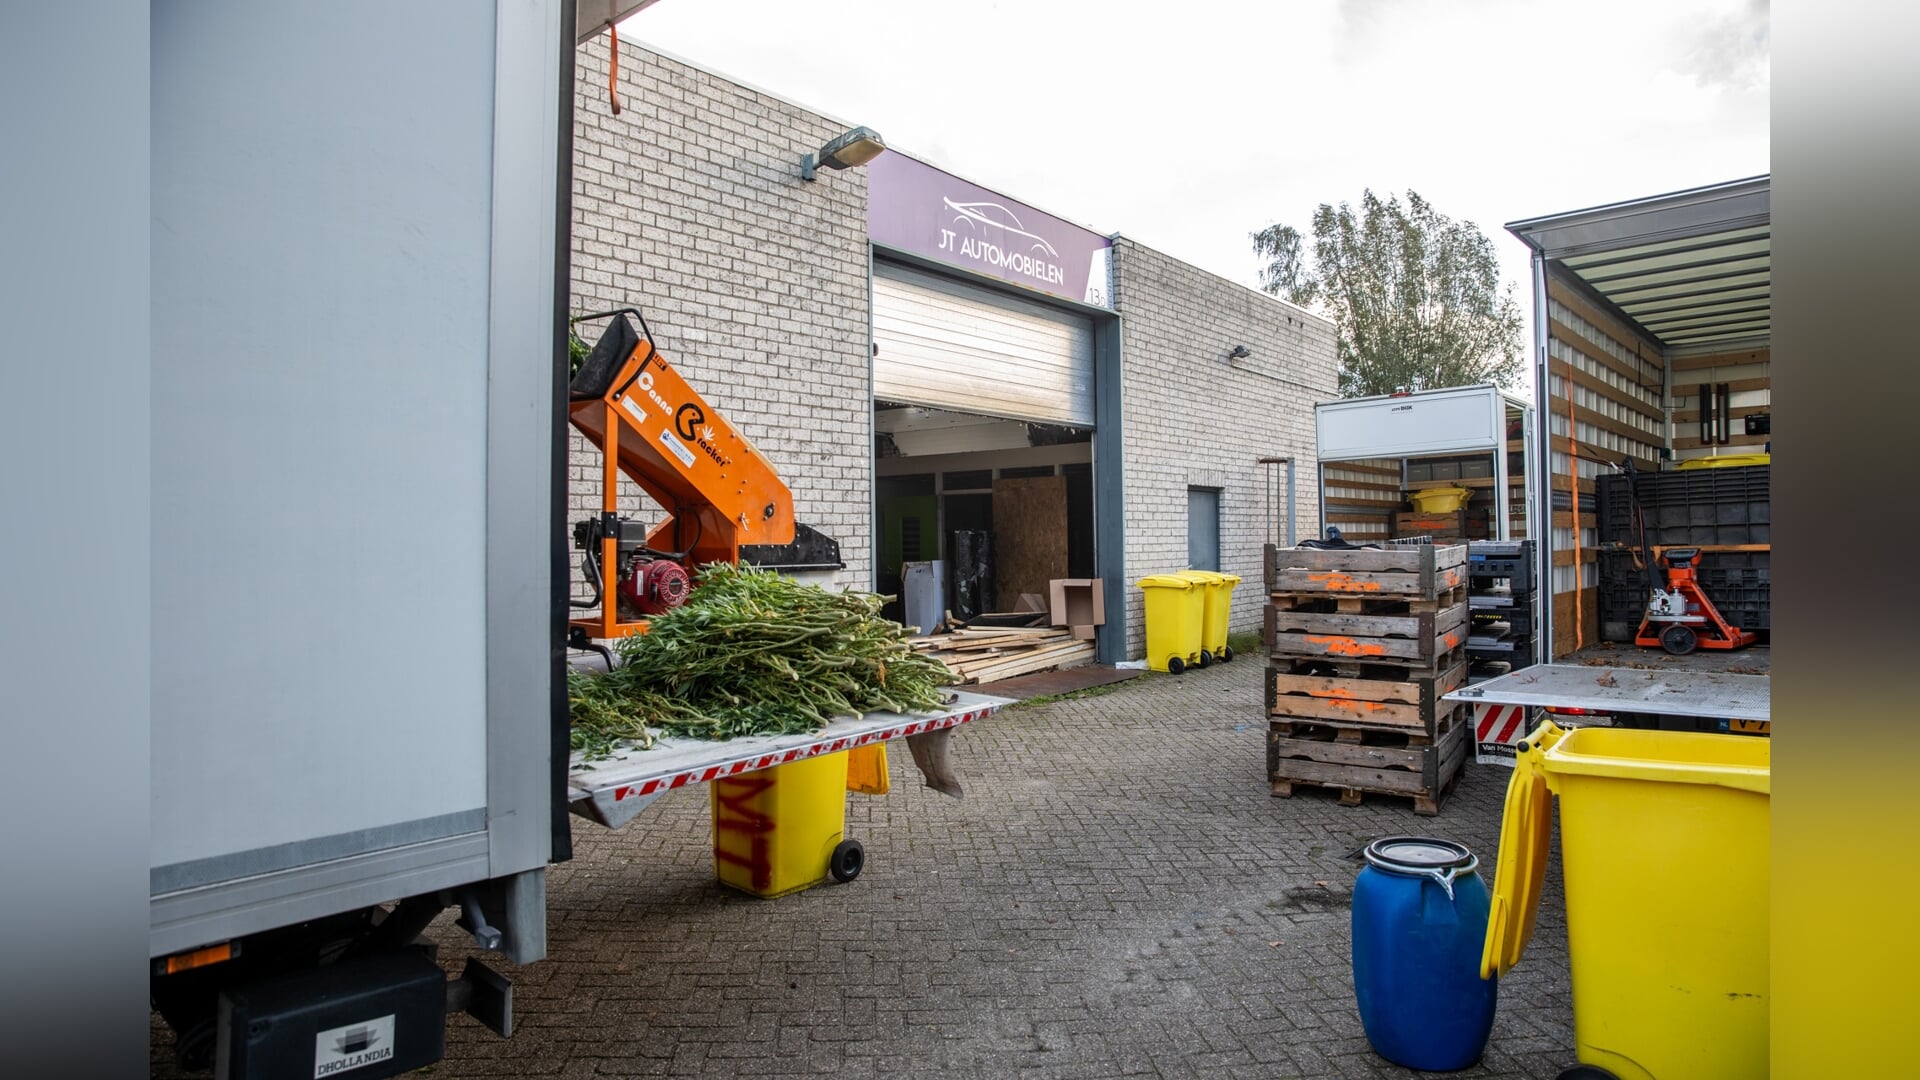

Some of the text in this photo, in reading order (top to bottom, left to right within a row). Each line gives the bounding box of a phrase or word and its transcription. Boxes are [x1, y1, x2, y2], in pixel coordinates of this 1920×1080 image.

[938, 229, 1063, 286] JT AUTOMOBIELEN
[638, 371, 673, 416] Canna
[317, 1047, 392, 1075] DHOLLANDIA
